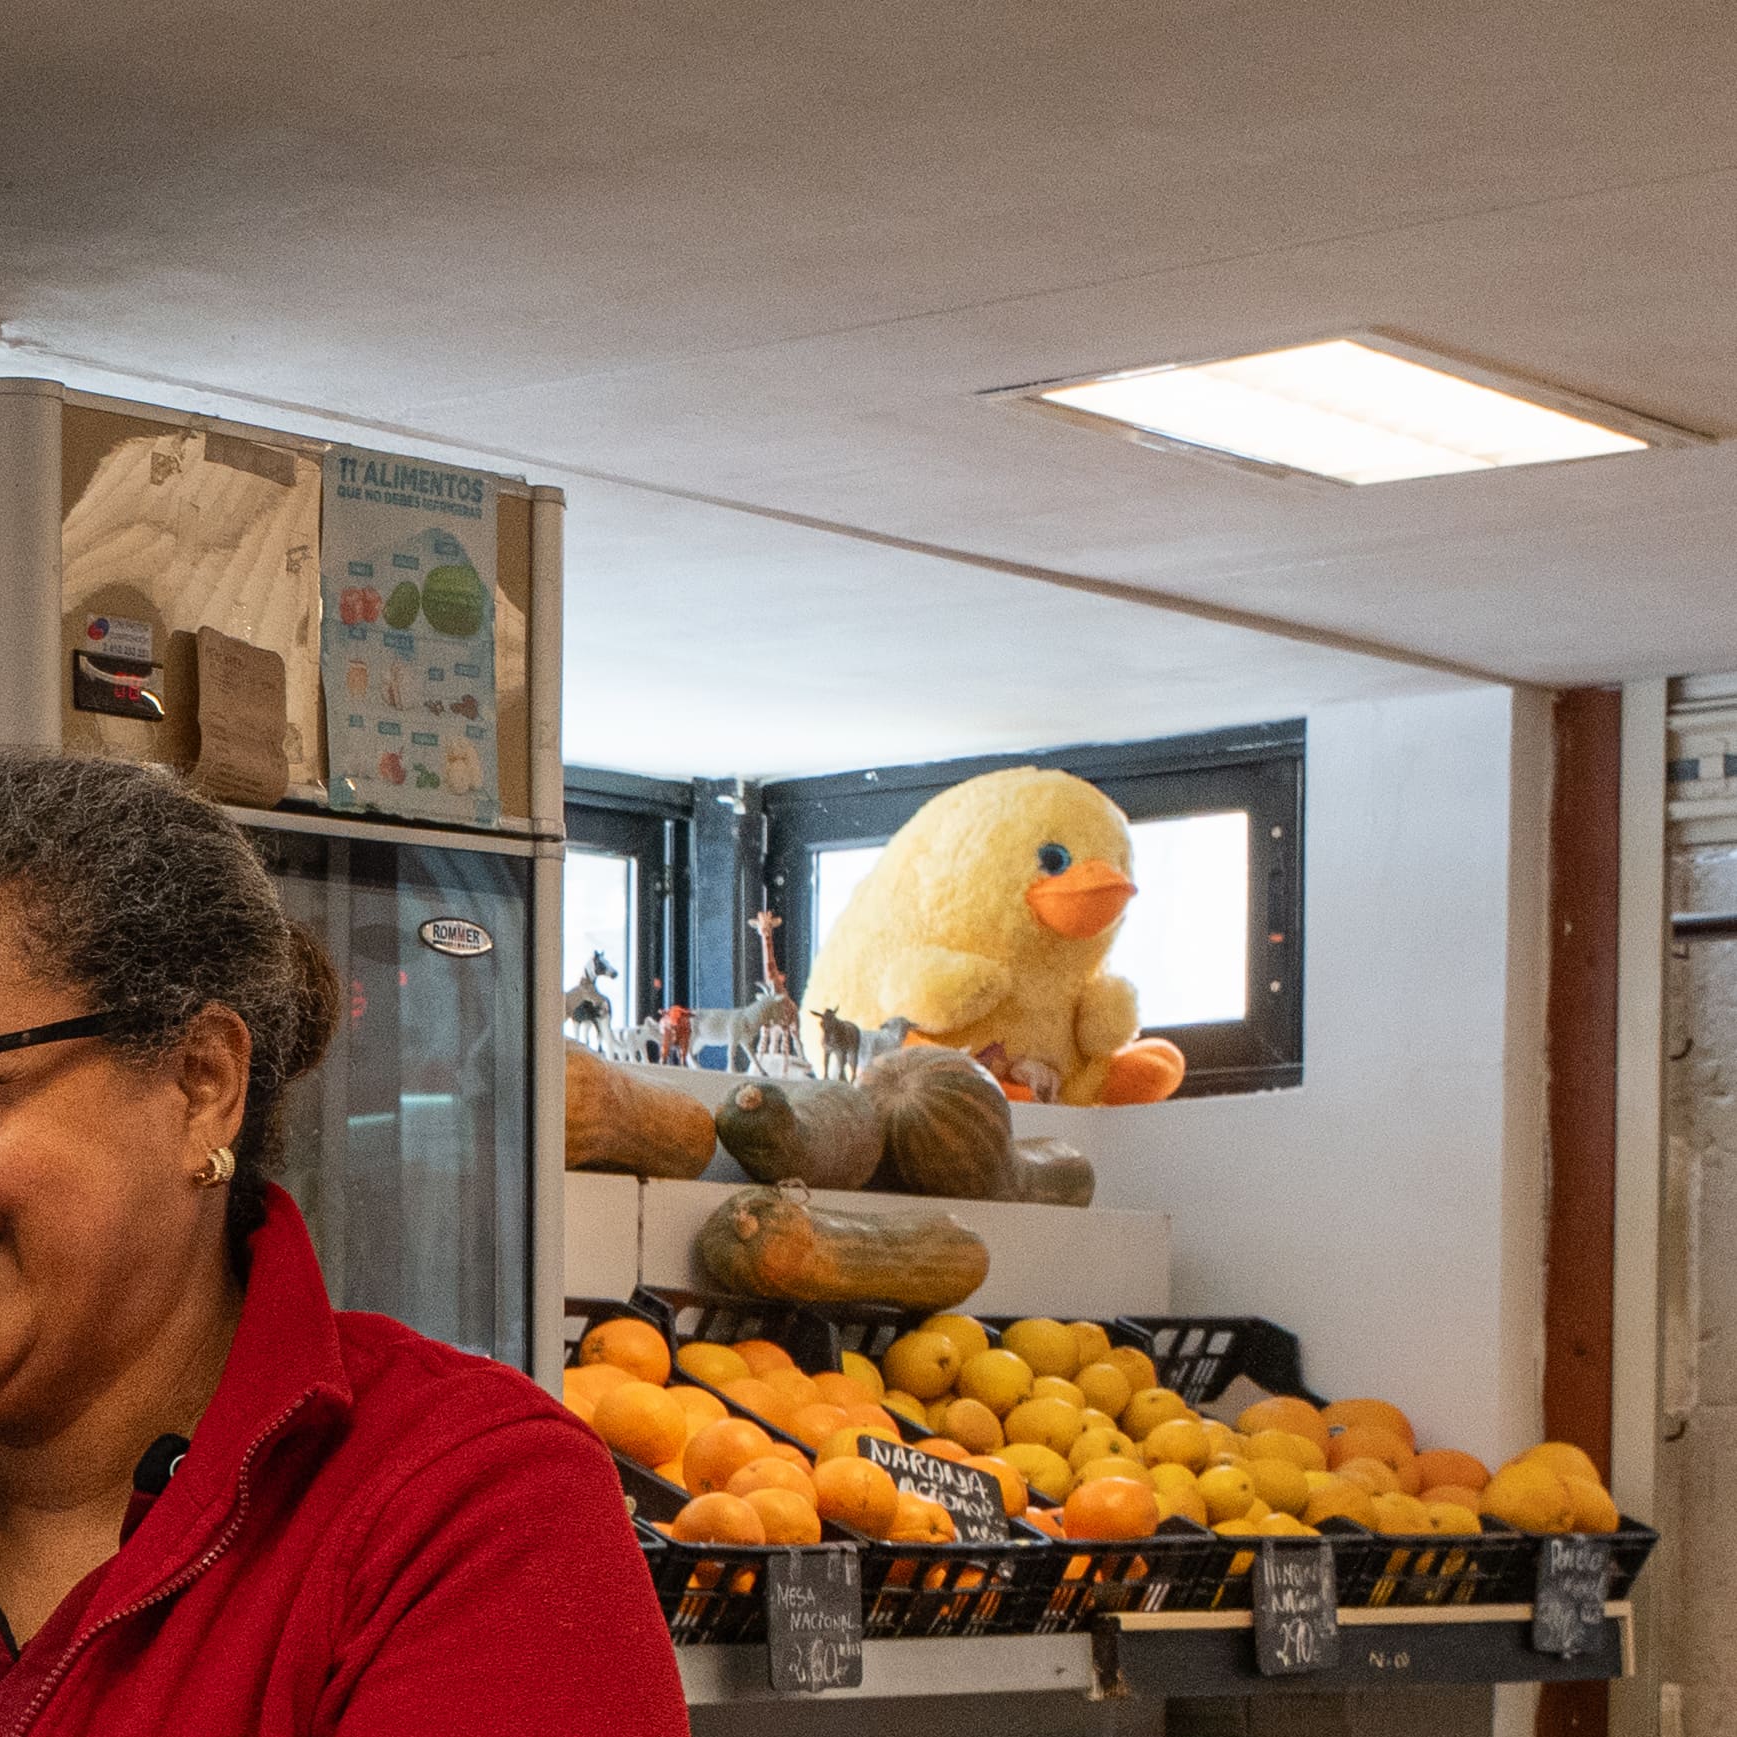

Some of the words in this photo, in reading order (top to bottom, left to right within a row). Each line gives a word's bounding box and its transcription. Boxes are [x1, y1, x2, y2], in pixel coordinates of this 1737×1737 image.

[363, 461, 484, 503] ALIMENTOS
[337, 485, 362, 499] QUE
[365, 489, 381, 502] NO
[385, 492, 419, 508] DEBES
[433, 924, 480, 943] ROMMER
[775, 1583, 816, 1610] MESA
